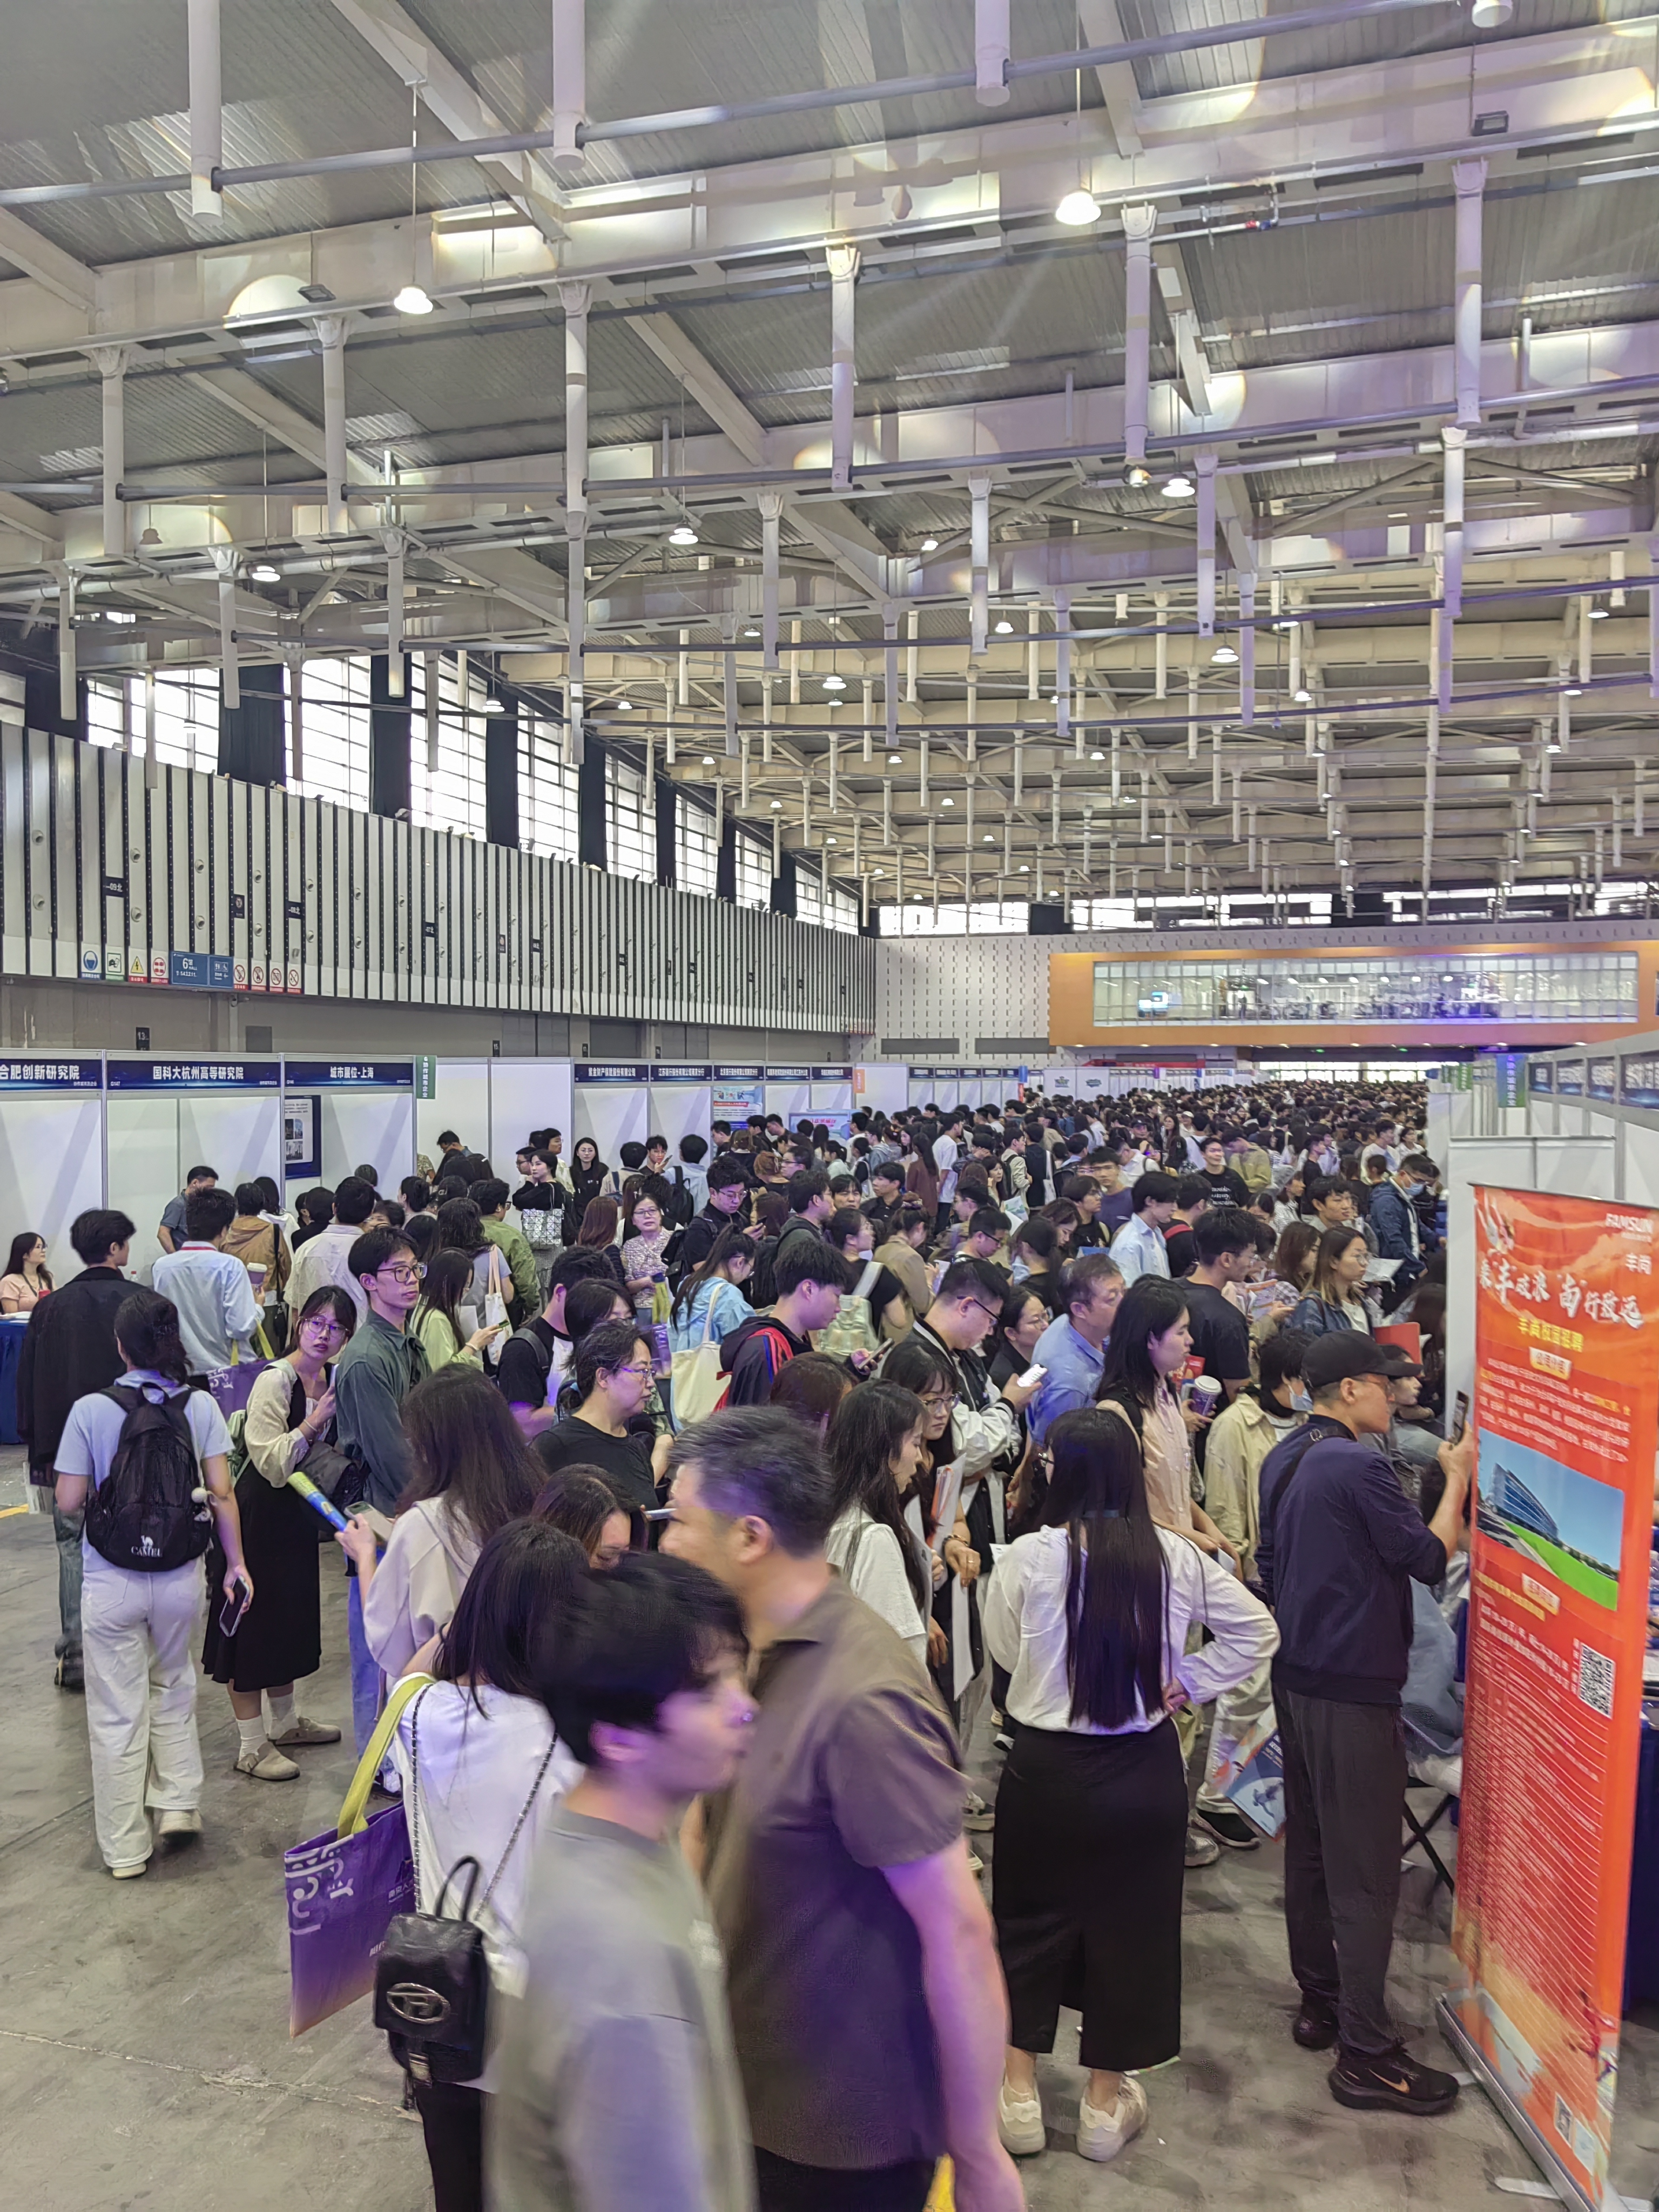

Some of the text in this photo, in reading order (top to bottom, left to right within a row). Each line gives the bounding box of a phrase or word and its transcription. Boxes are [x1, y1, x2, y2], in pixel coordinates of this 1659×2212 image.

[0, 1064, 80, 1080] 合肥创新研究院
[153, 1065, 244, 1080] 国科大杭州高等研究院
[330, 1067, 374, 1078] 城市展位-上海
